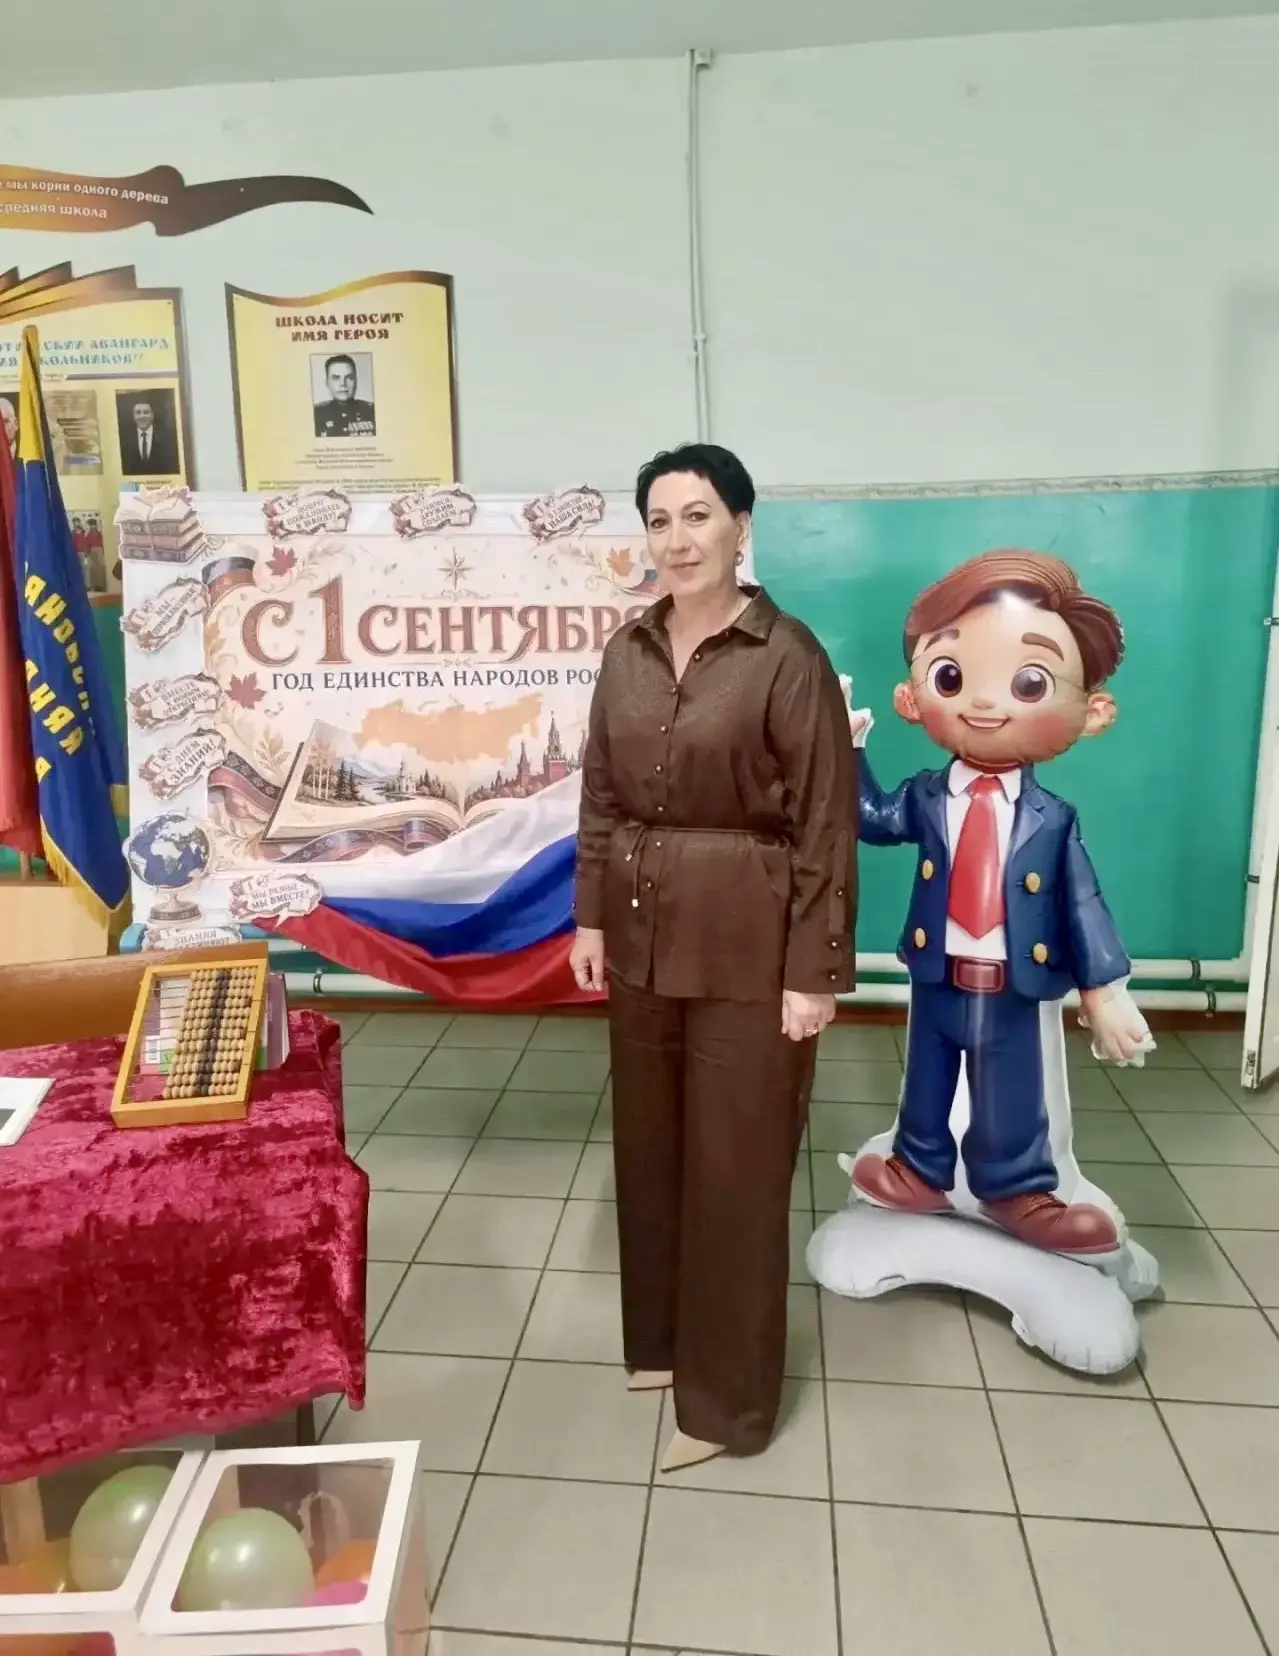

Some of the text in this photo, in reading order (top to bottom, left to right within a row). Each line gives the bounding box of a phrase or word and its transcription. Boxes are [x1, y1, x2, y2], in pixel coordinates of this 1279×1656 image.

[31, 181, 70, 192] корни
[74, 183, 118, 197] одного
[121, 188, 169, 205] дерева
[60, 204, 107, 219] школа
[275, 312, 404, 328] ШКОЛА НОСИТ
[291, 328, 390, 342] ИМЯ ГЕРОЯ
[240, 598, 299, 667] С
[308, 575, 352, 665] 1
[272, 672, 314, 691] ГОД
[323, 670, 445, 691] ЕДИНСТВА
[453, 668, 559, 688] НАРОДОВ
